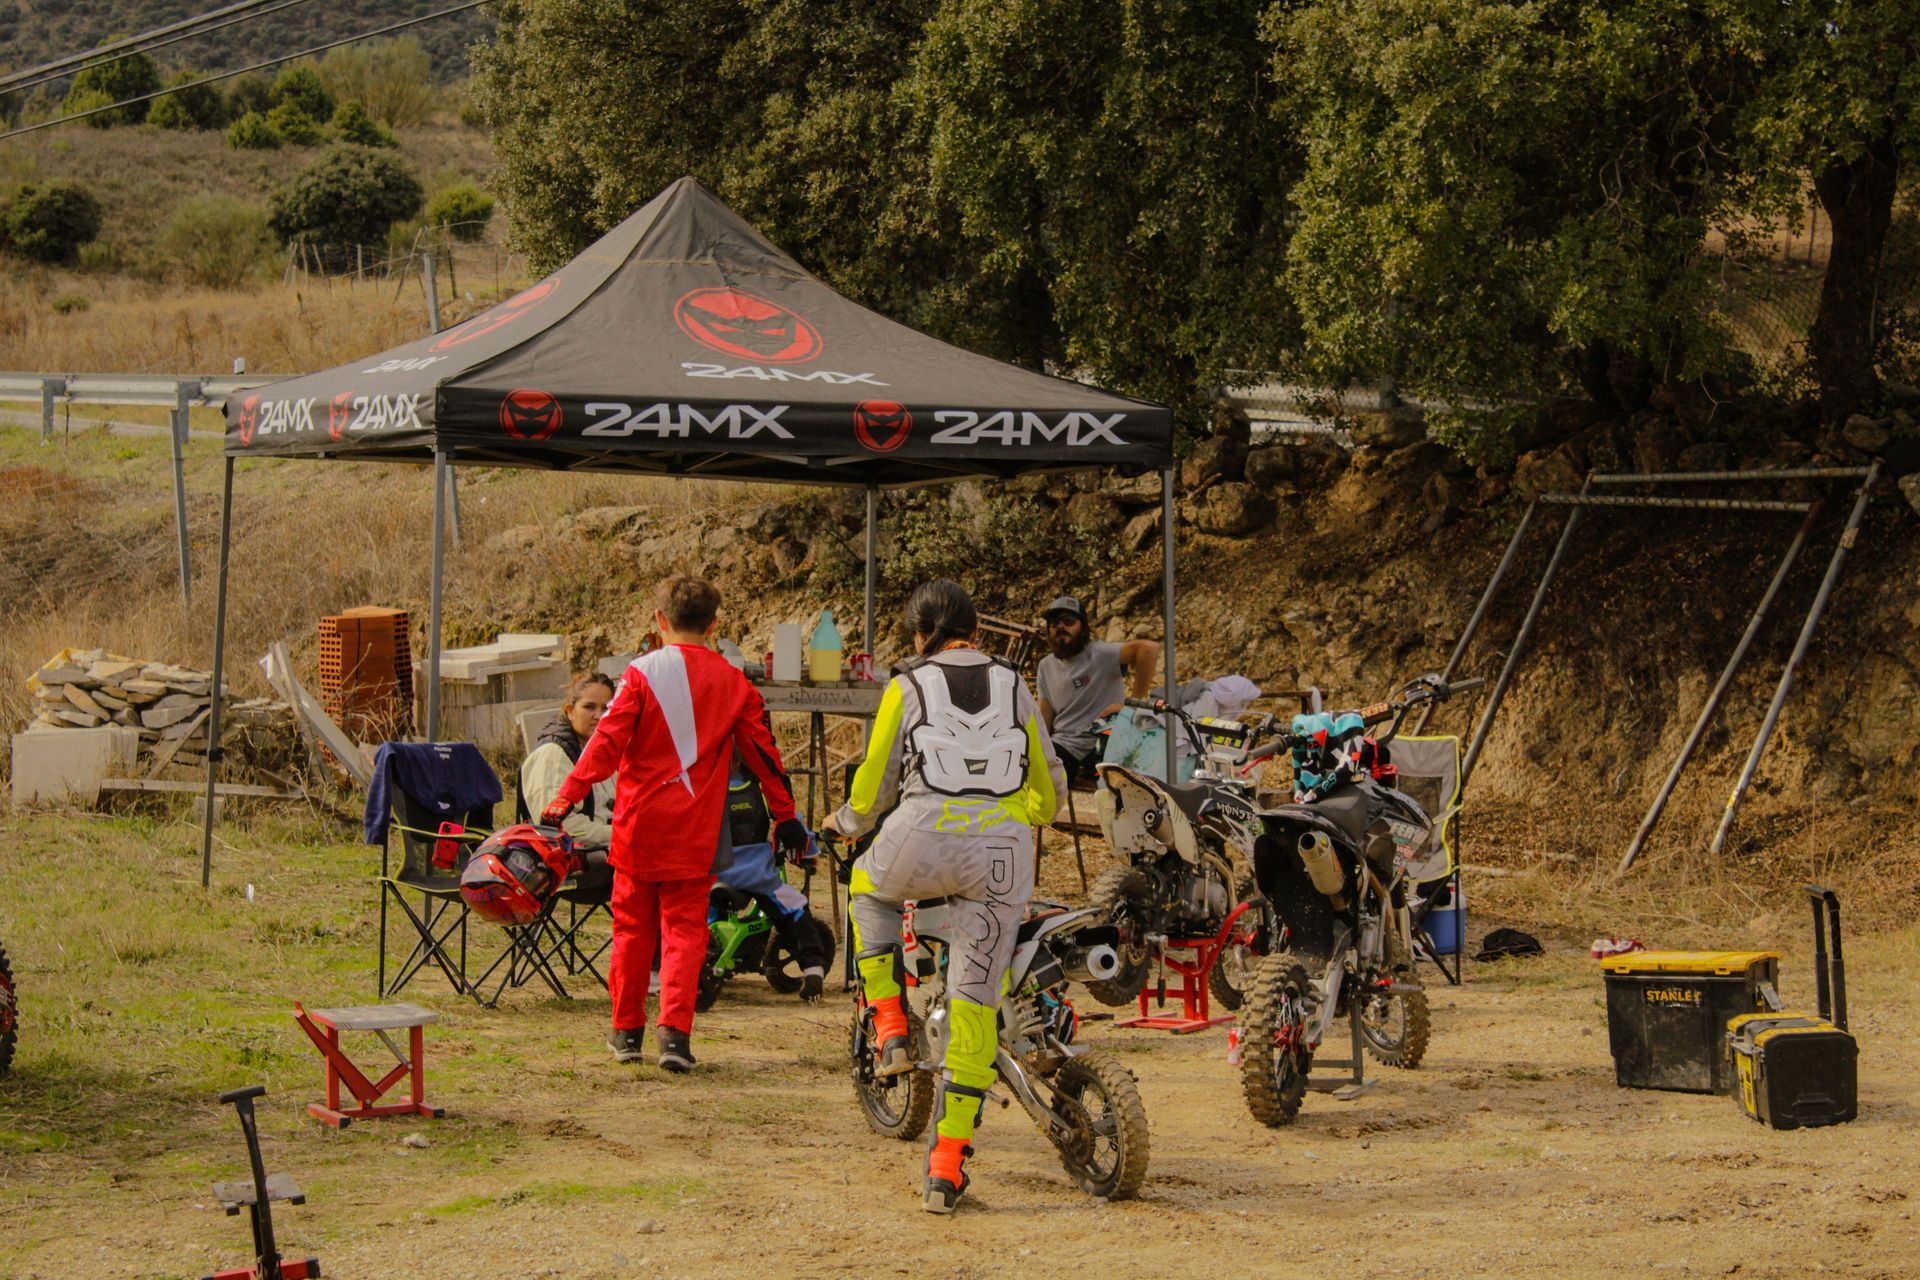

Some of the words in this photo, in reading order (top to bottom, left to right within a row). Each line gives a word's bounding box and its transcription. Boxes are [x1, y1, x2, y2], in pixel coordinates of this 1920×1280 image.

[681, 362, 890, 386] 24MX
[257, 396, 316, 435] 24MX
[349, 392, 423, 431] 24MX
[581, 402, 796, 440] 24MX
[929, 410, 1131, 446] 24MX
[1646, 990, 1703, 1002] STANLEY
